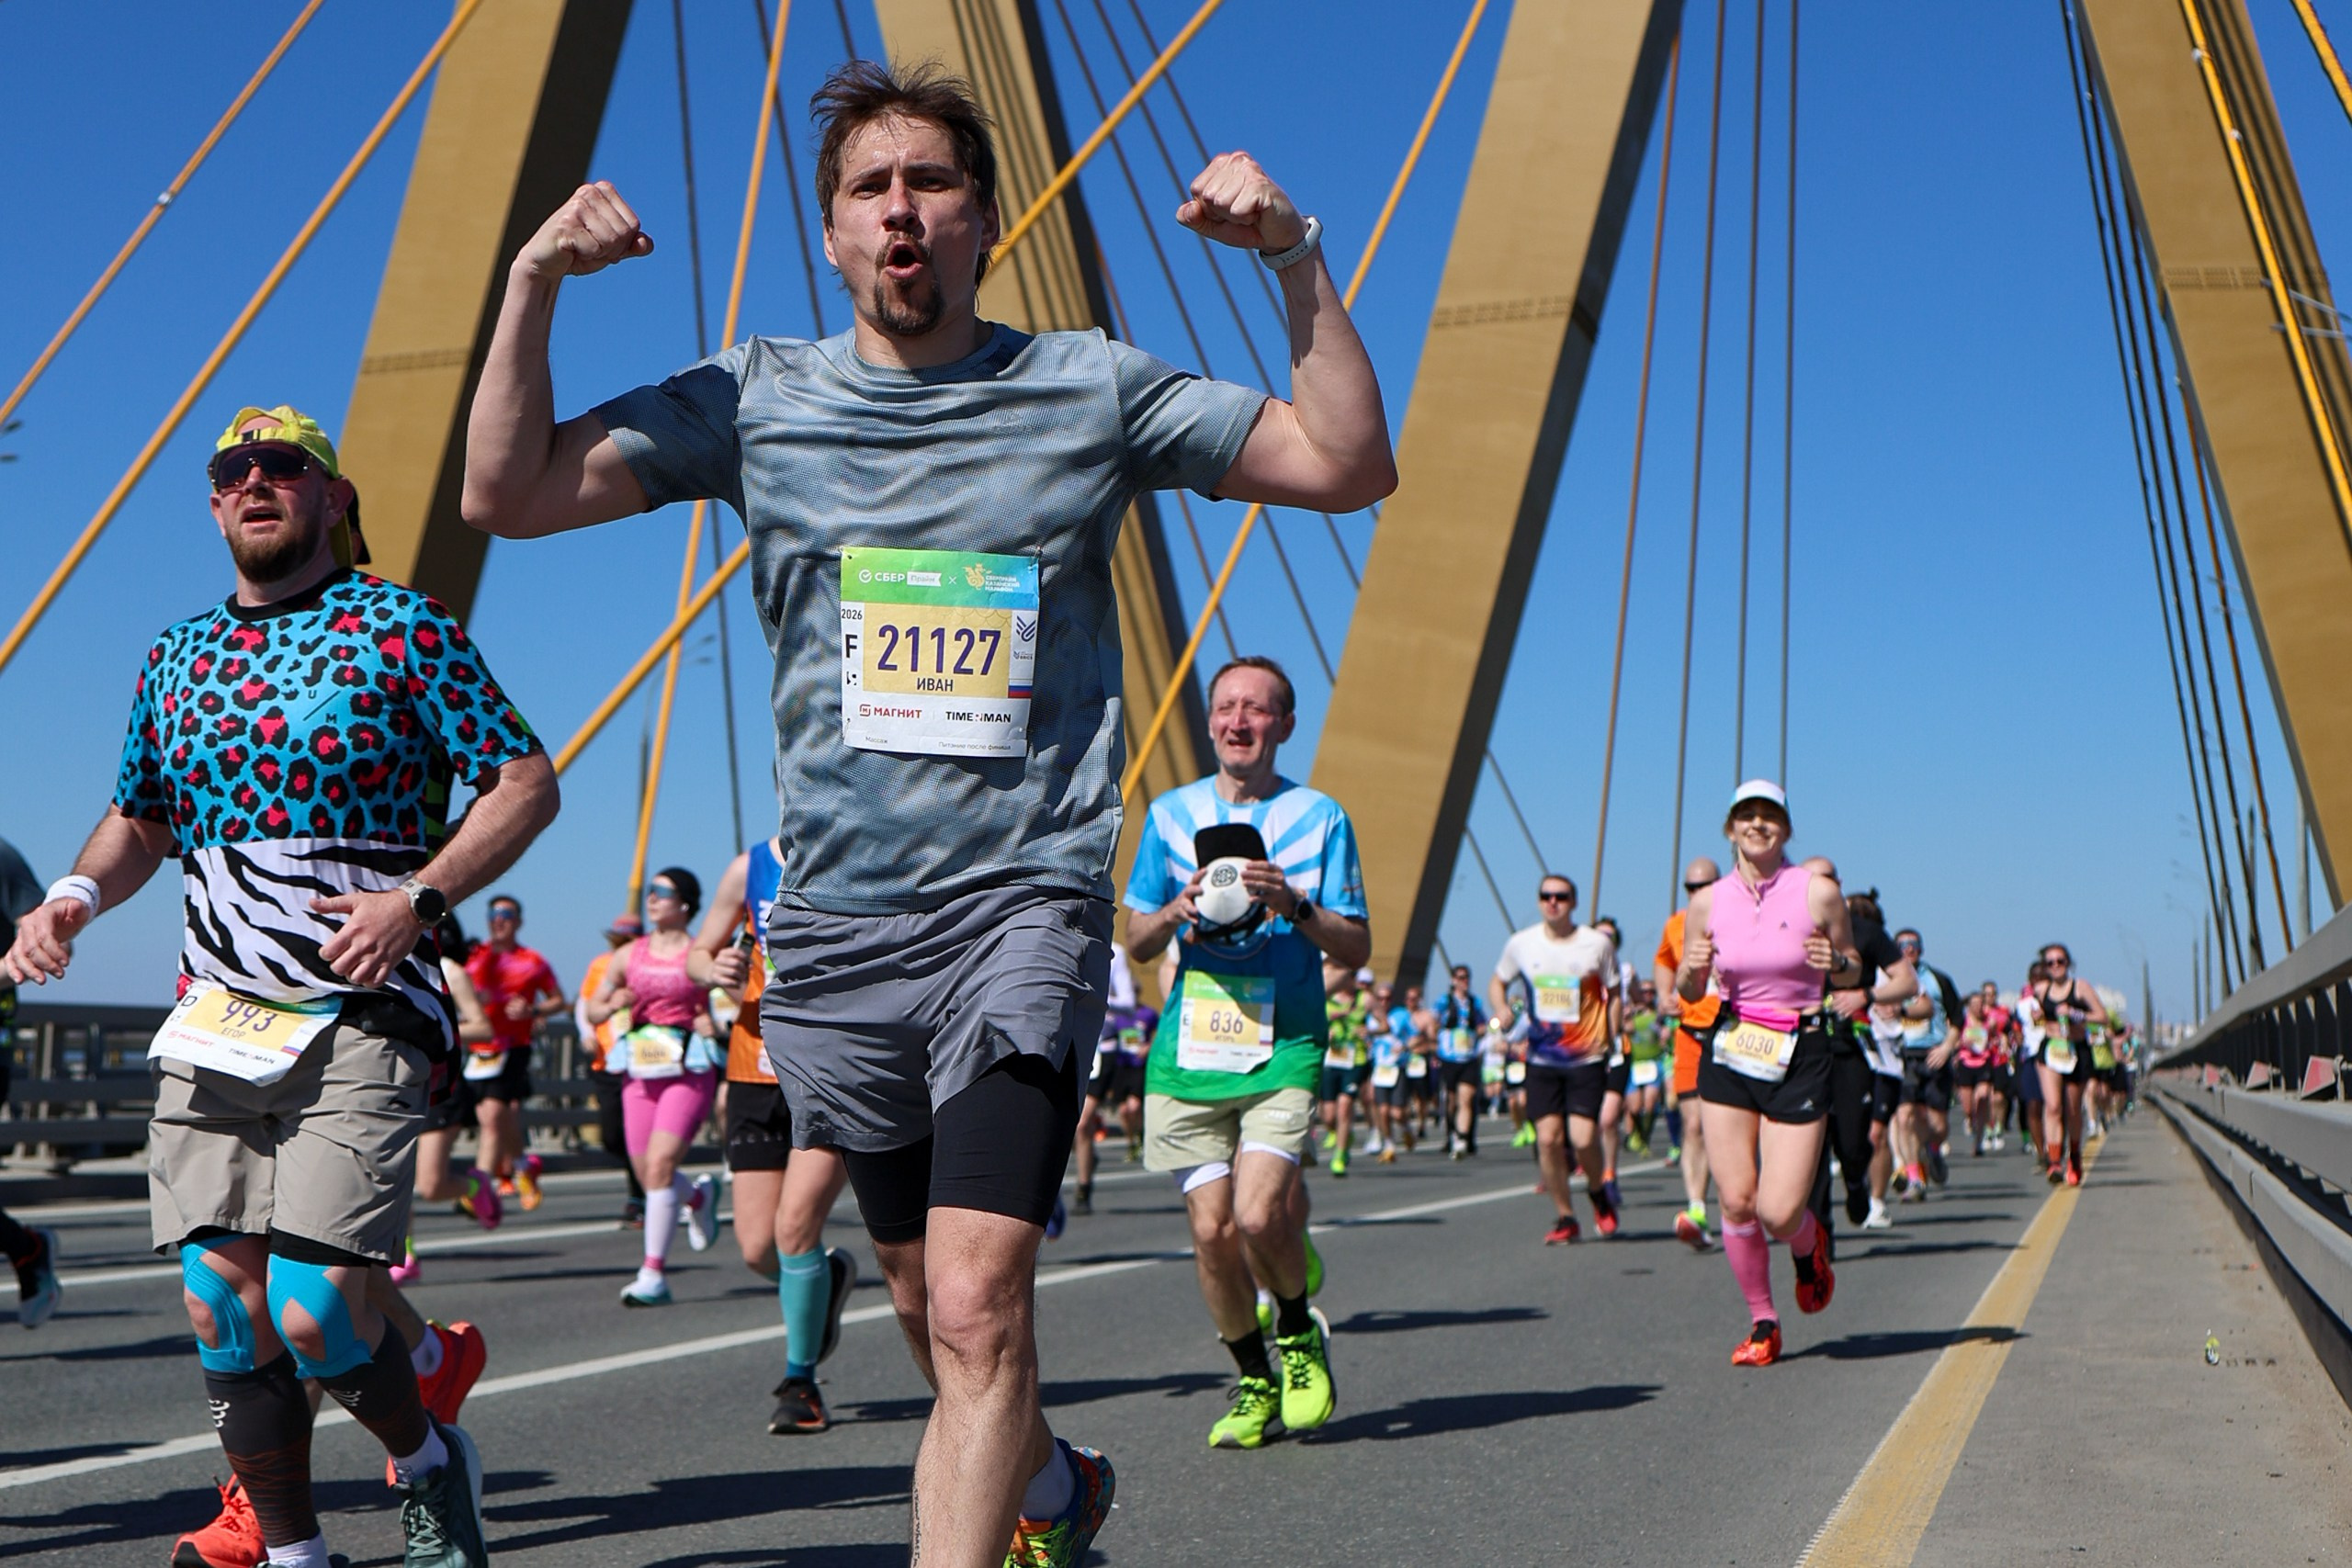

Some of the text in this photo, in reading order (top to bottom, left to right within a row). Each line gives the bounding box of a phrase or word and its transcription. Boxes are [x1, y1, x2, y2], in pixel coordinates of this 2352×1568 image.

[875, 571, 906, 583] СБЕР
[841, 608, 863, 620] 2026
[845, 633, 858, 659] F
[877, 624, 1001, 676] 21127
[917, 677, 954, 693] ИВАН
[874, 706, 922, 718] МАГНИТ
[219, 999, 278, 1032] 993
[1210, 1010, 1243, 1034] 836
[178, 1033, 215, 1047] МАГНИТ
[220, 1027, 246, 1039] ЕГОР
[1736, 1031, 1775, 1055] 6030
